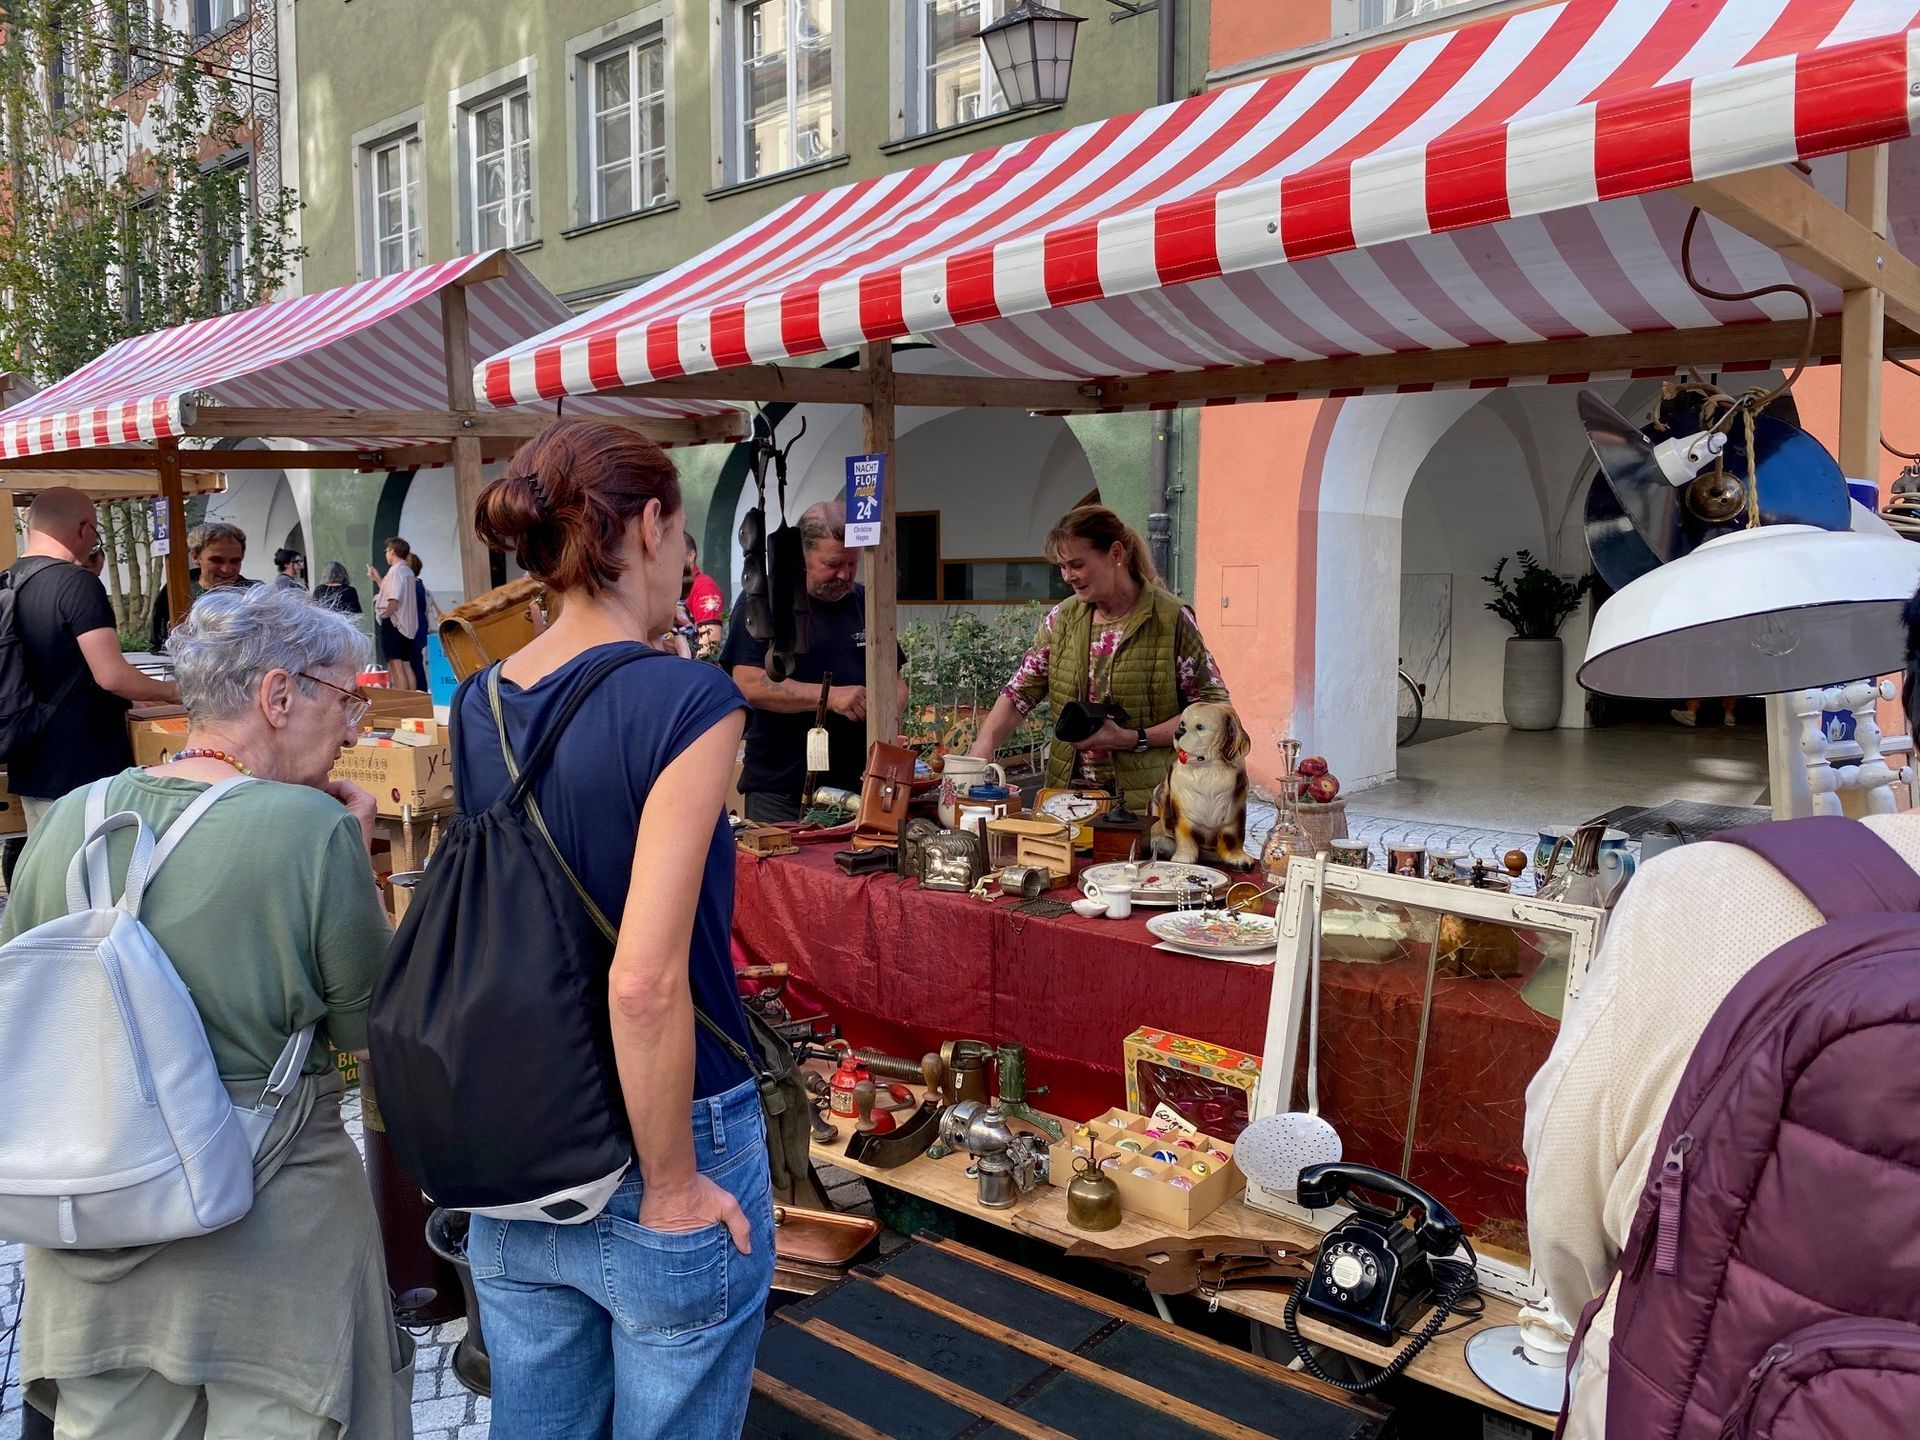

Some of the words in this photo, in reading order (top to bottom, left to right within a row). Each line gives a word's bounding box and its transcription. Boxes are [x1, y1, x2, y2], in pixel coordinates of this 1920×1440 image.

[855, 463, 878, 473] NACHT
[855, 474, 878, 486] FLOH
[856, 501, 872, 520] 24
